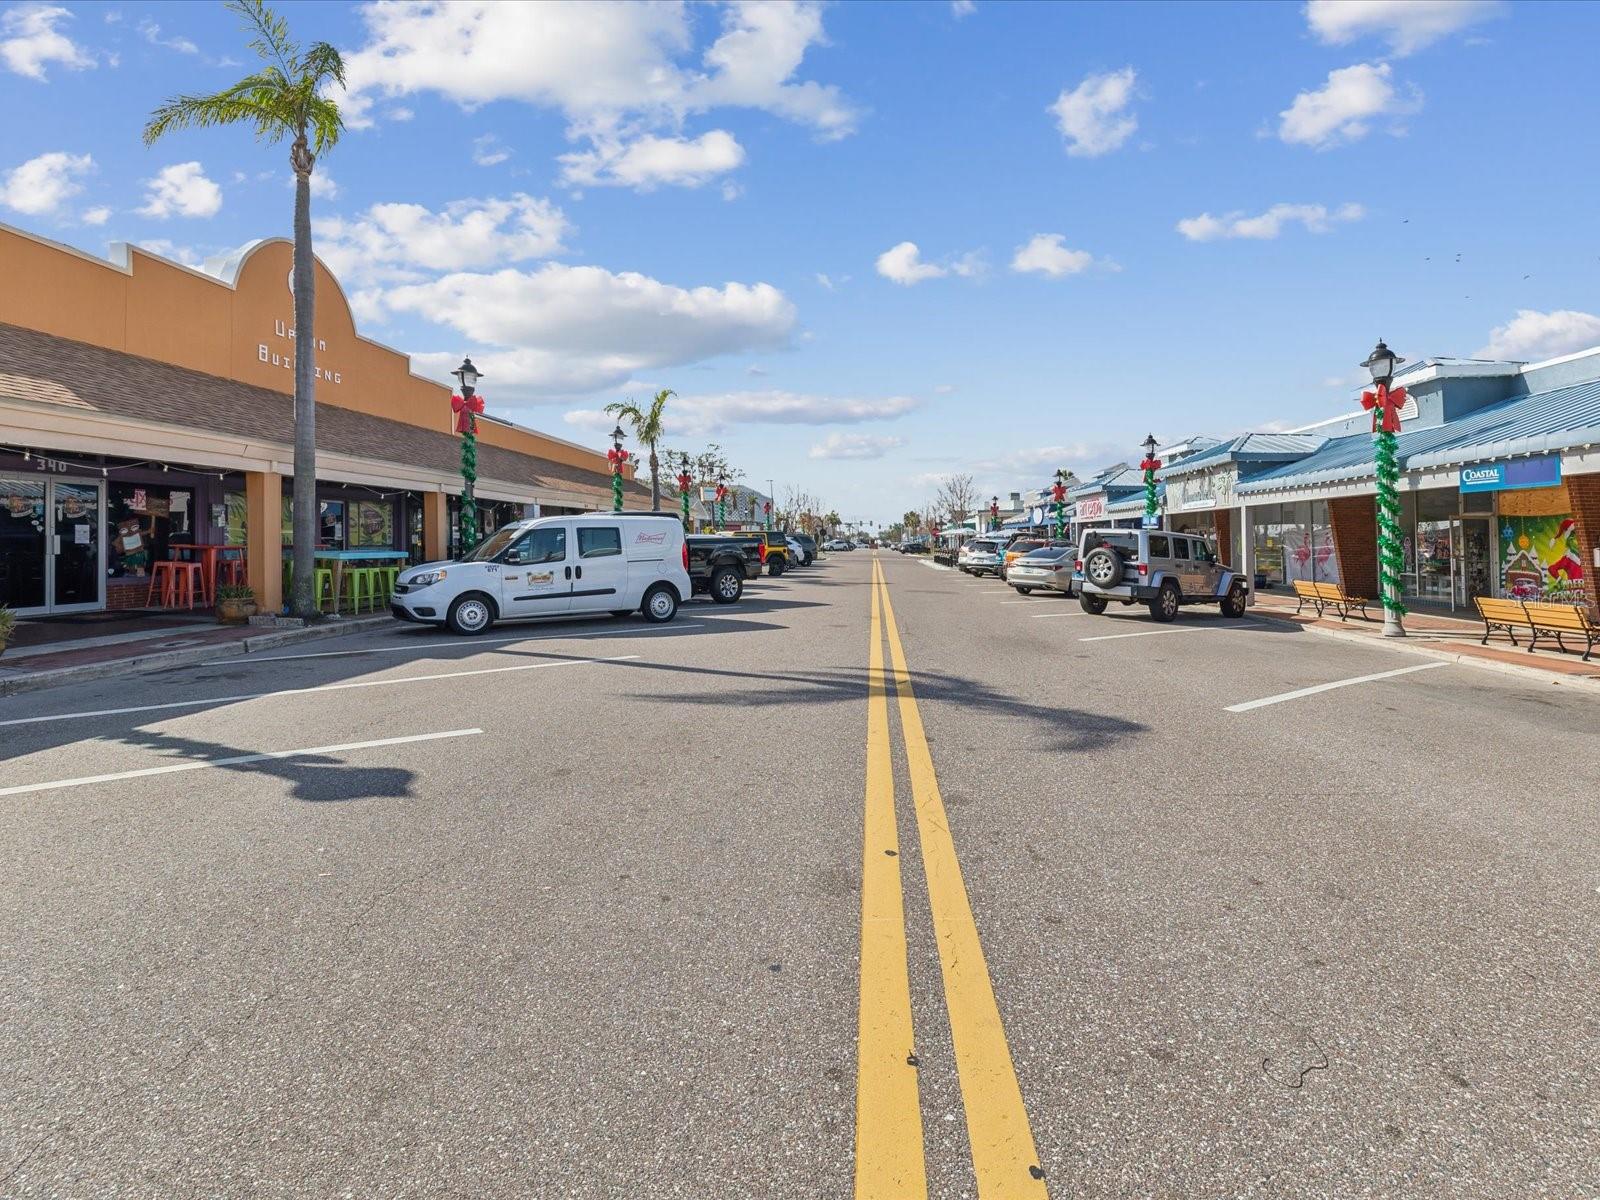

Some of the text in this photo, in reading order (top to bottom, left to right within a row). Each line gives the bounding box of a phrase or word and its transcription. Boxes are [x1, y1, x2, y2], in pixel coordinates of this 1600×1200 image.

[258, 344, 341, 384] BUIING
[37, 458, 67, 472] 340
[1462, 468, 1500, 482] COASTAL
